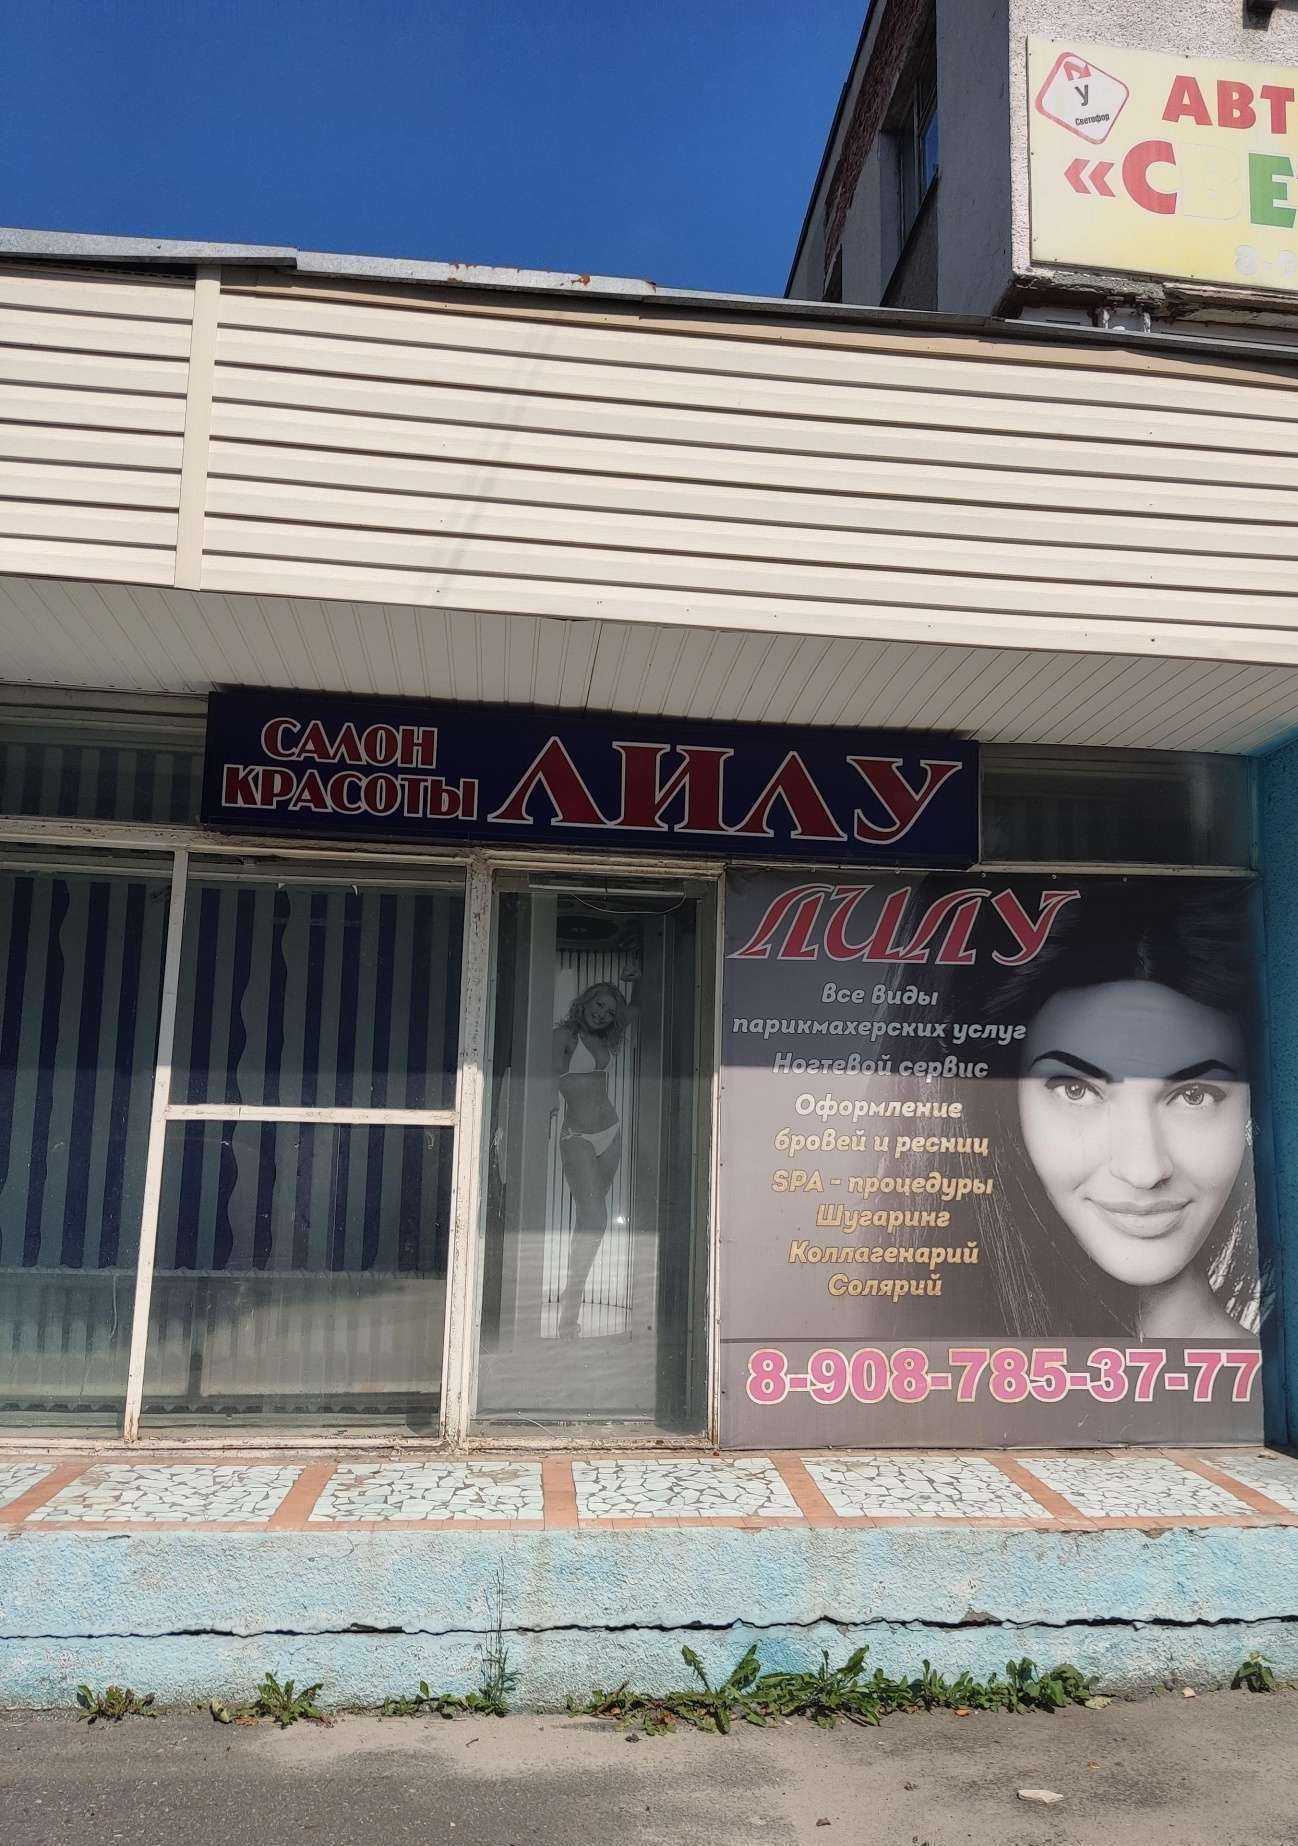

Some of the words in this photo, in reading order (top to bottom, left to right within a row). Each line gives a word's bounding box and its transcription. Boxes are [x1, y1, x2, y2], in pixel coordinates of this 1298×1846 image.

[1075, 113, 1110, 126] Светофор
[1162, 75, 1295, 134] АВТ
[260, 717, 439, 769] САЛОН
[221, 764, 479, 820] КРАСОТЫ
[487, 736, 963, 845] ЛИЛУ
[724, 883, 1081, 966] ЛИЛУ
[871, 984, 939, 1006] виды
[732, 1016, 946, 1041] парикмахерских
[952, 1022, 1027, 1044] услуг
[772, 1052, 892, 1077] Ногтевой
[898, 1055, 990, 1083] сервис
[795, 1093, 963, 1122] Оформление
[774, 1127, 867, 1156] бровей
[872, 1137, 890, 1151] и
[895, 1135, 990, 1158] ресниц
[771, 1169, 825, 1194] SPA
[847, 1172, 995, 1200] процедуры
[816, 1203, 951, 1234] Шугаринг
[787, 1240, 979, 1270] Коллагенарий
[827, 1273, 943, 1303] Солярий
[747, 1347, 1262, 1404] 8-908-785-37-77
